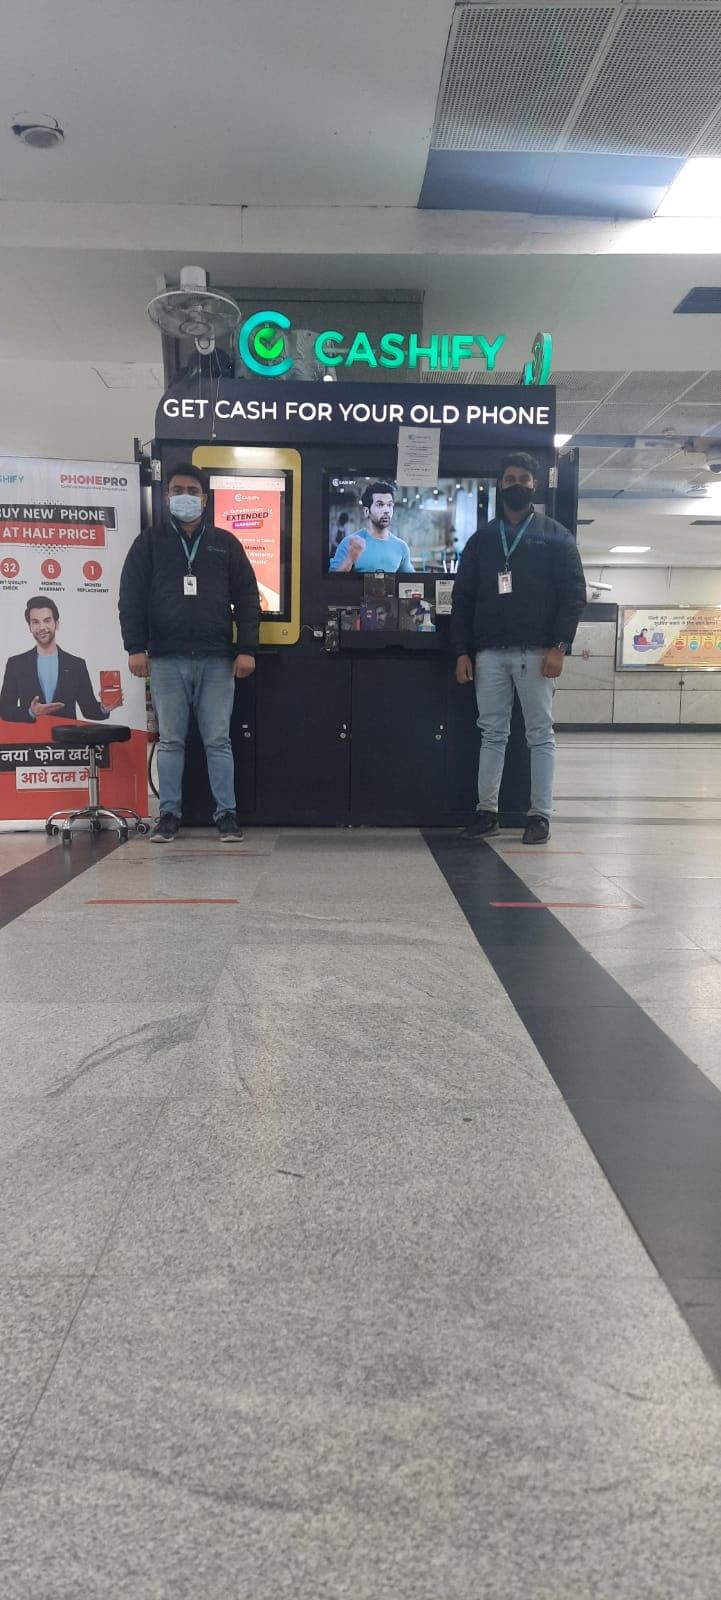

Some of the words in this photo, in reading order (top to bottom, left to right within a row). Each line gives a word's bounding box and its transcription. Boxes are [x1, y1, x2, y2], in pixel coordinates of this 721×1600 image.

[314, 331, 507, 371] CASHIFY
[163, 399, 208, 419] GET
[215, 400, 277, 420] CASH
[285, 402, 332, 421] FOR
[338, 403, 403, 423] YOUR
[410, 404, 460, 424] OLD
[466, 406, 550, 425] PHONE
[60, 474, 128, 487] PHONEPRO
[60, 510, 105, 521] PHONE
[226, 511, 269, 522] EXTENDED
[2, 527, 20, 538] AT
[22, 527, 56, 539] HALF
[58, 528, 97, 540] PRICE
[3, 562, 17, 573] 32
[47, 564, 55, 574] 6
[89, 565, 95, 576] 1
[21, 768, 48, 784] आधे
[51, 771, 76, 784] दाम
